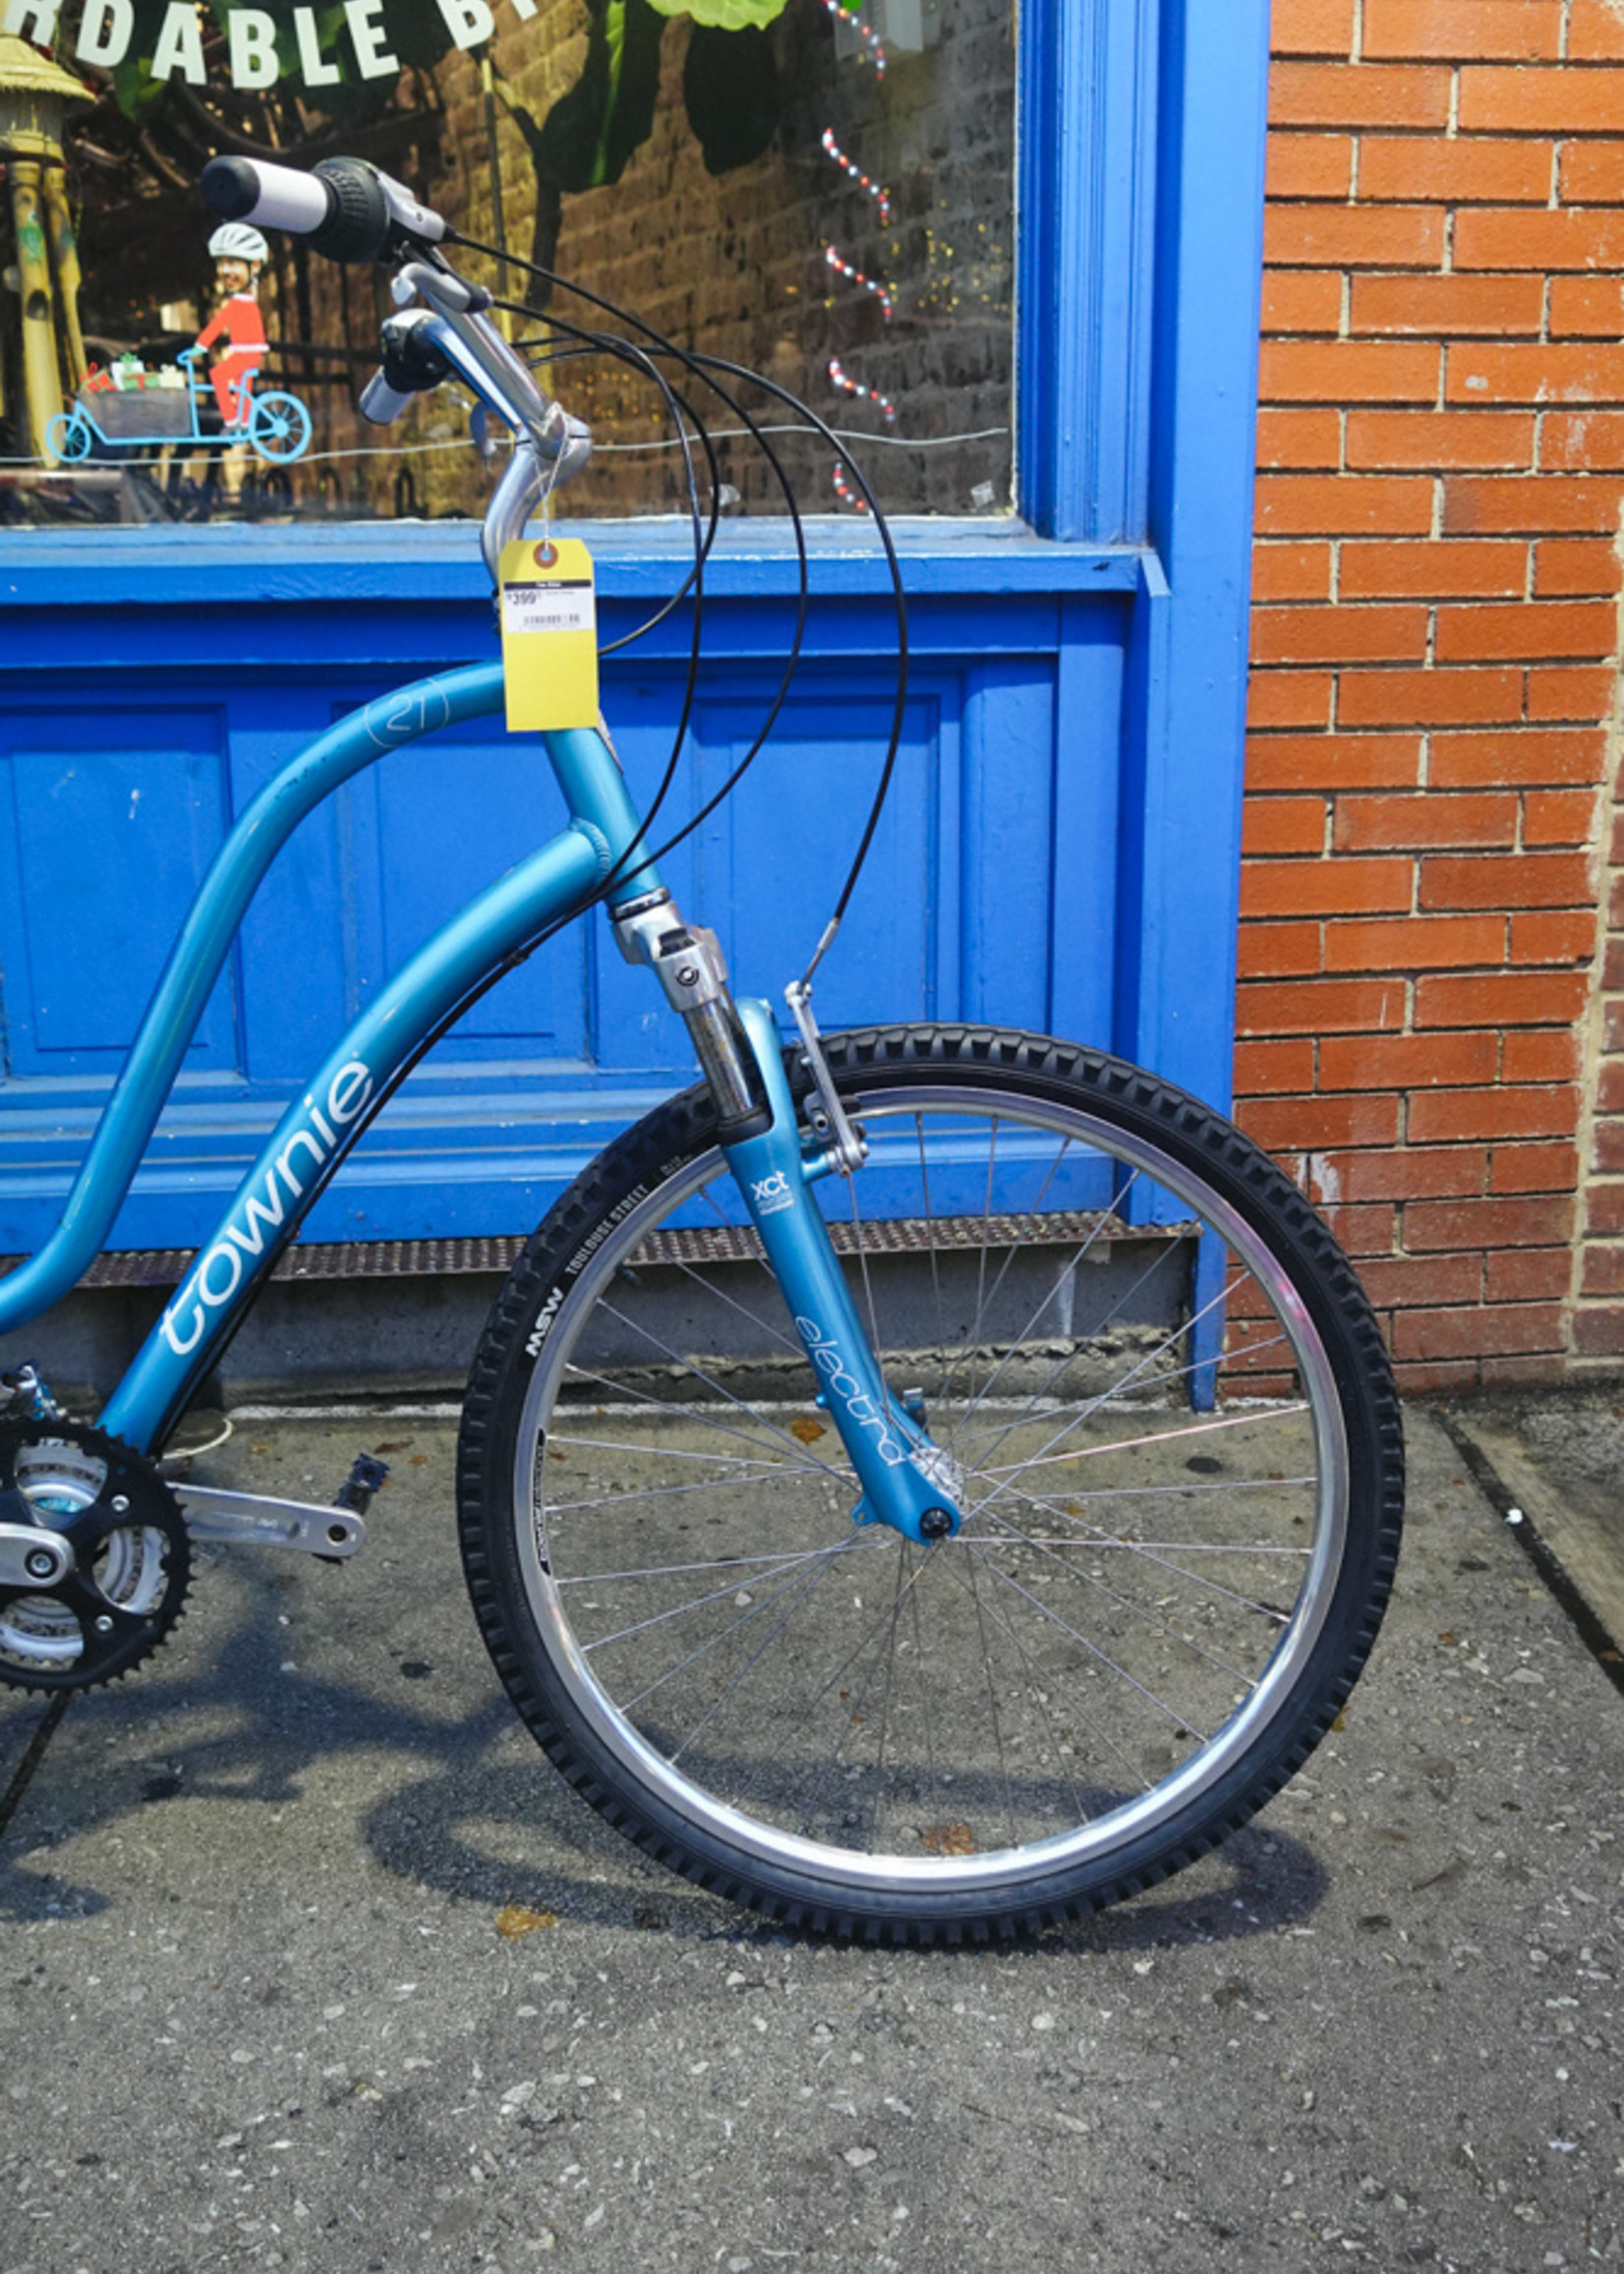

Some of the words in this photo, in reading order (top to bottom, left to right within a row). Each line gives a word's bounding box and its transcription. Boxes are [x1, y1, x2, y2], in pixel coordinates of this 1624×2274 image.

[386, 693, 427, 731] 21
[160, 1060, 373, 1356] townie
[609, 1183, 649, 1222] STREET
[750, 1170, 789, 1200] xct
[525, 1286, 564, 1358] MSW
[795, 1315, 906, 1467] electra
